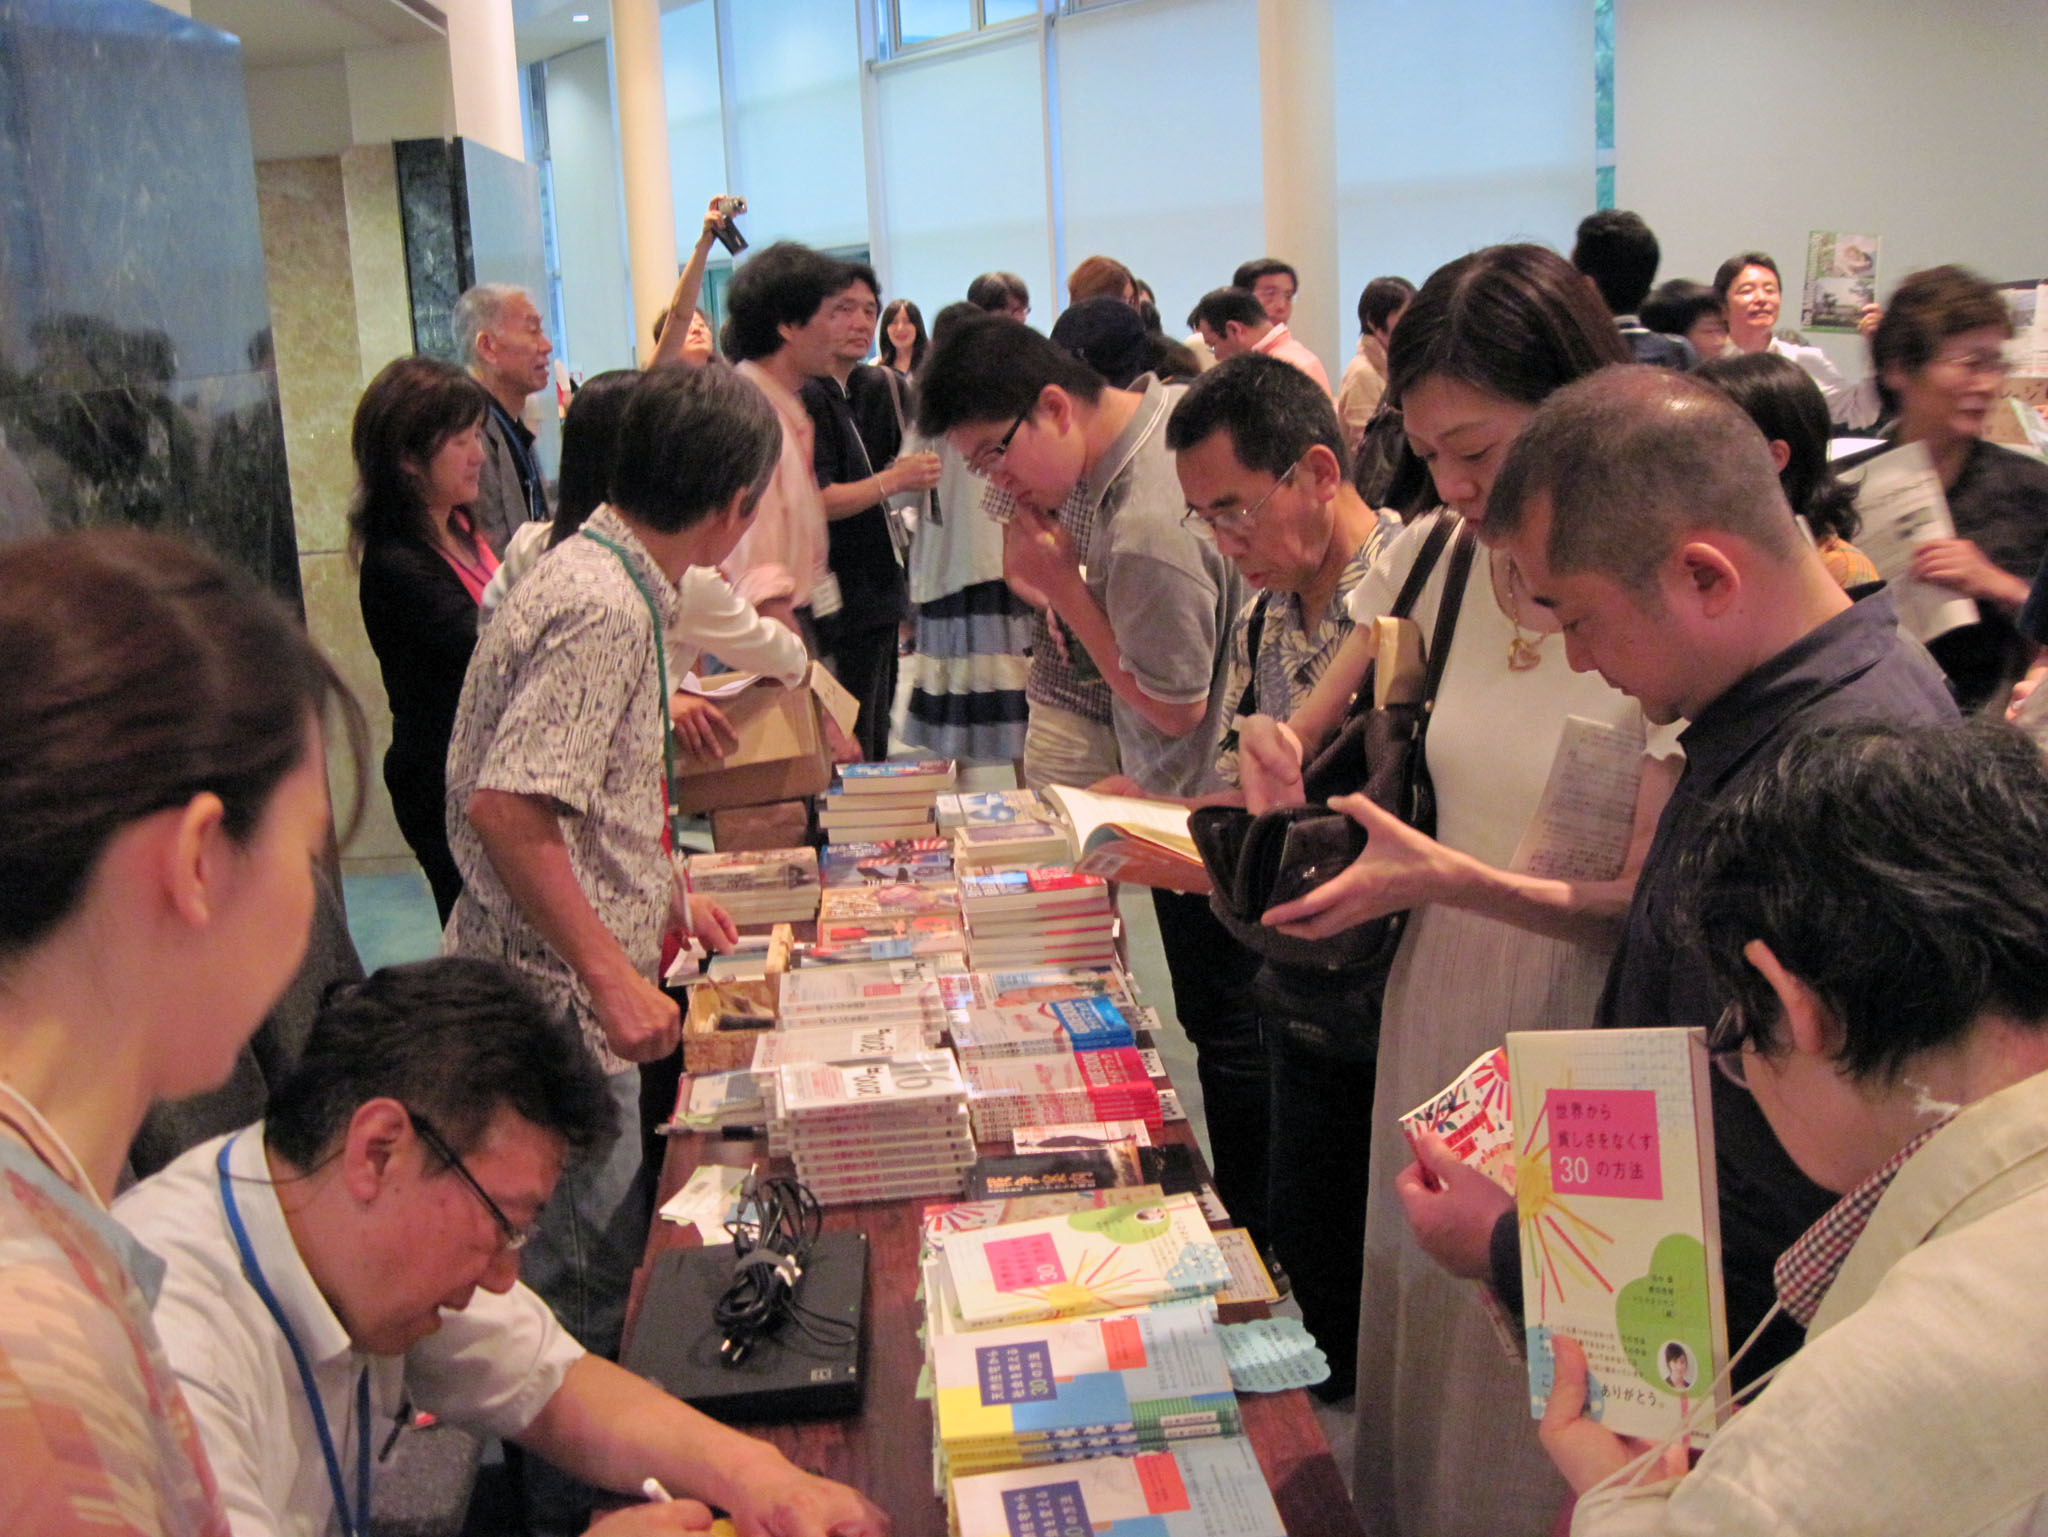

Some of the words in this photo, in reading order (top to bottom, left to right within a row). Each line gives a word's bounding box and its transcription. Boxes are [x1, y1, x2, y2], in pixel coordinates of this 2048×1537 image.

[1556, 1101, 1611, 1120] 世界から
[1558, 1130, 1653, 1151] 貧しさをなくす
[1035, 1490, 1059, 1537] 会を変える
[1059, 1495, 1084, 1537] 0の方法
